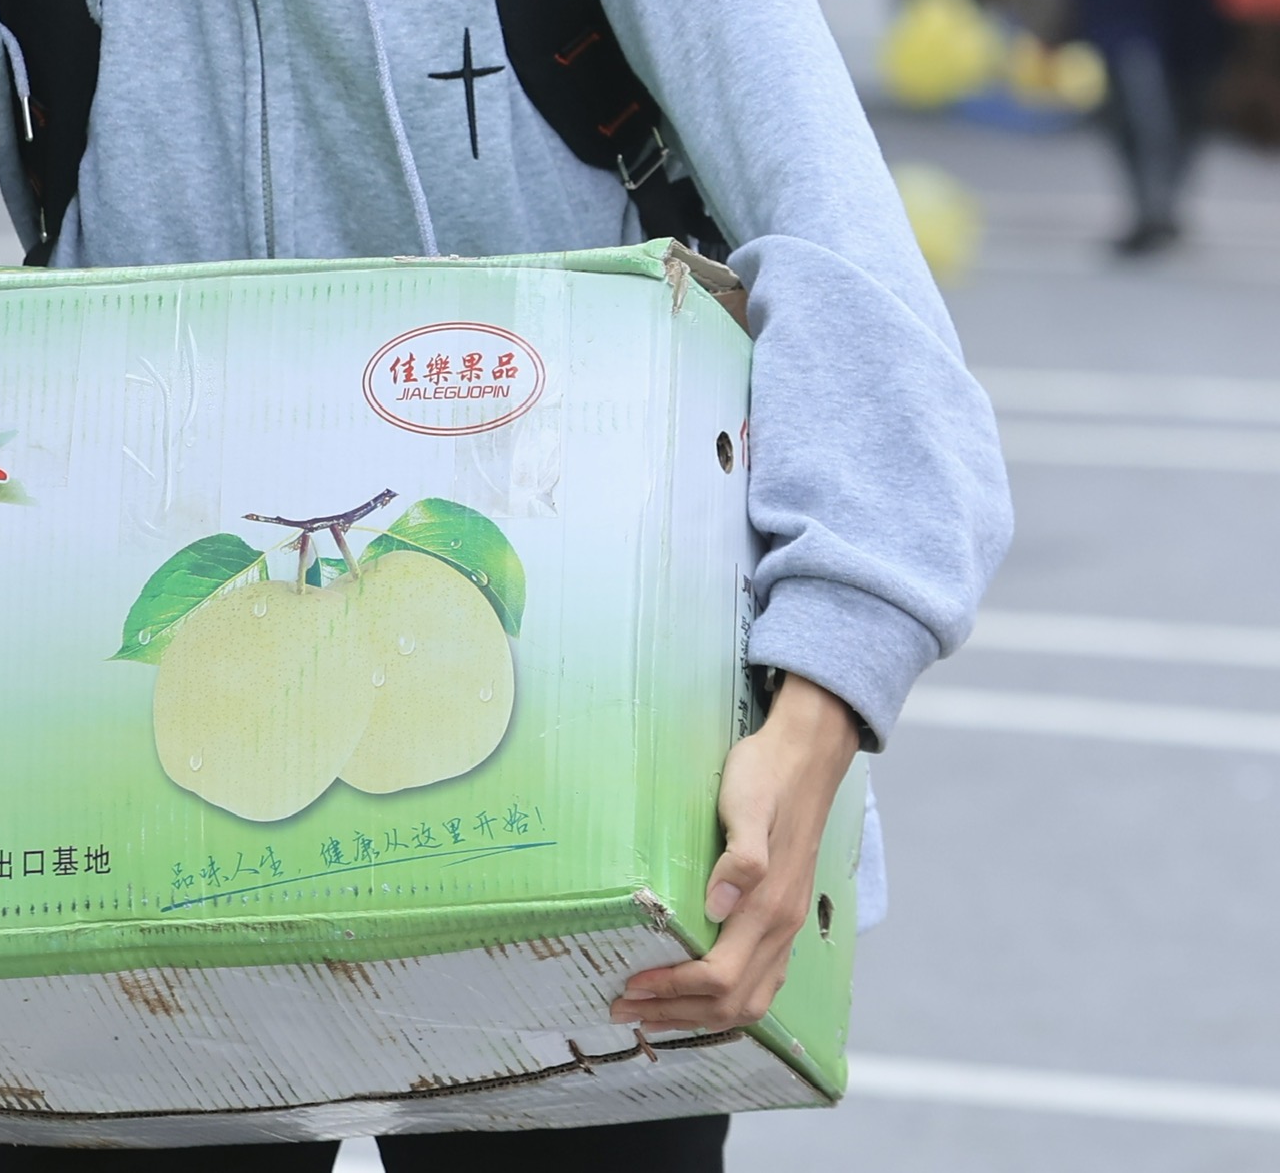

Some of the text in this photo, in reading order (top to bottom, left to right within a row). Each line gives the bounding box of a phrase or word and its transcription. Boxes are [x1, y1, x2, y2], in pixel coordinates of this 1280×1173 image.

[389, 352, 519, 385] 佳樂果品
[396, 385, 511, 401] JIALEGUOPIN
